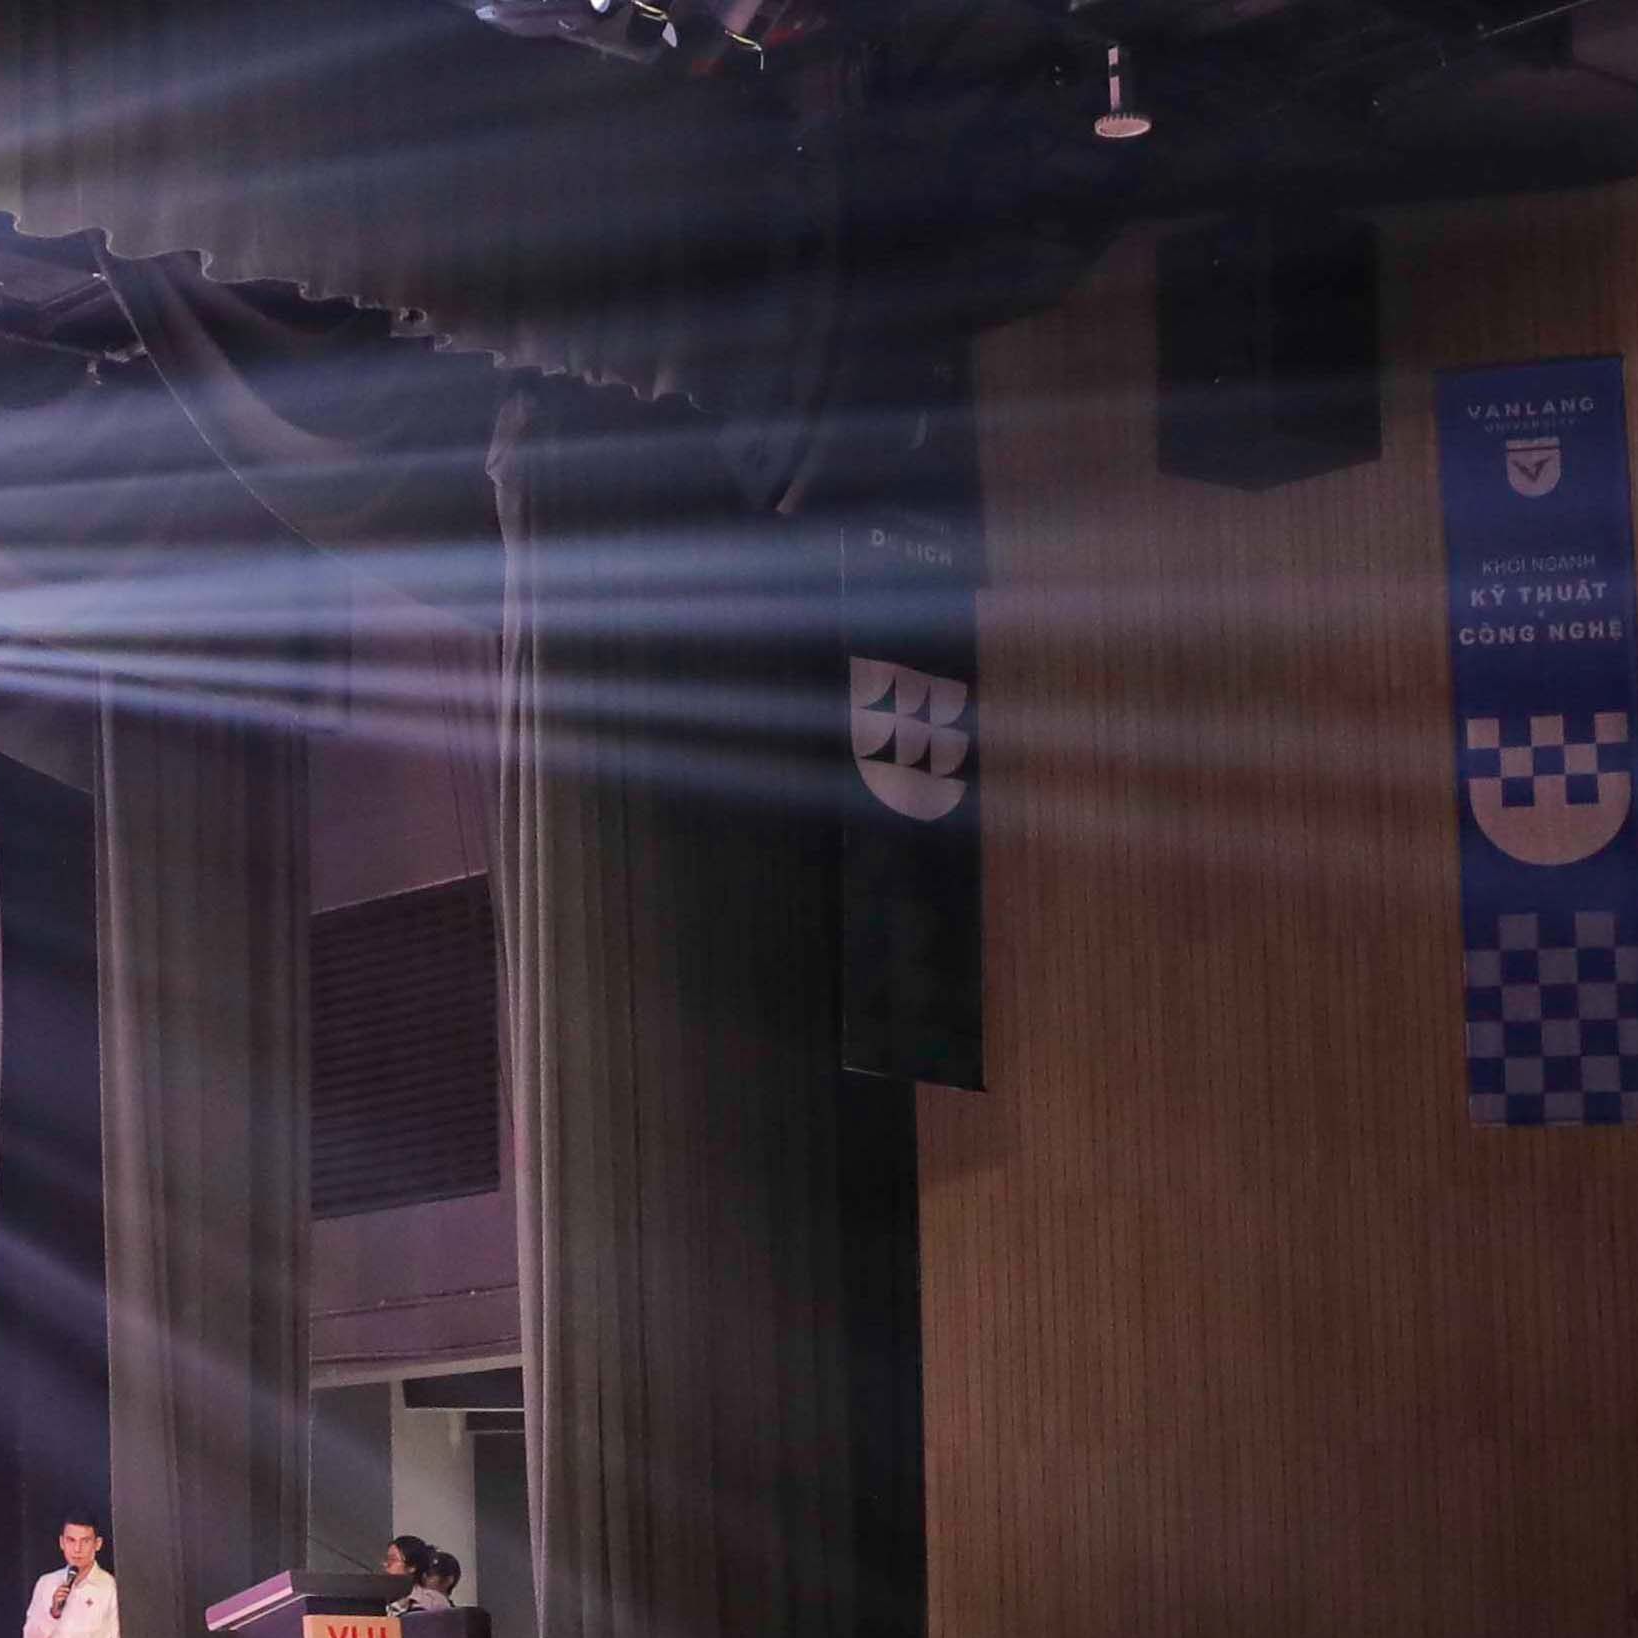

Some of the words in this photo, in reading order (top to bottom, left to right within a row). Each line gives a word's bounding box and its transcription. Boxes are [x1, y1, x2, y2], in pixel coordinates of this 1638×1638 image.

[1467, 396, 1594, 420] VANLANG
[1517, 578, 1608, 606] THUẬT
[1458, 621, 1536, 646] CÔNG
